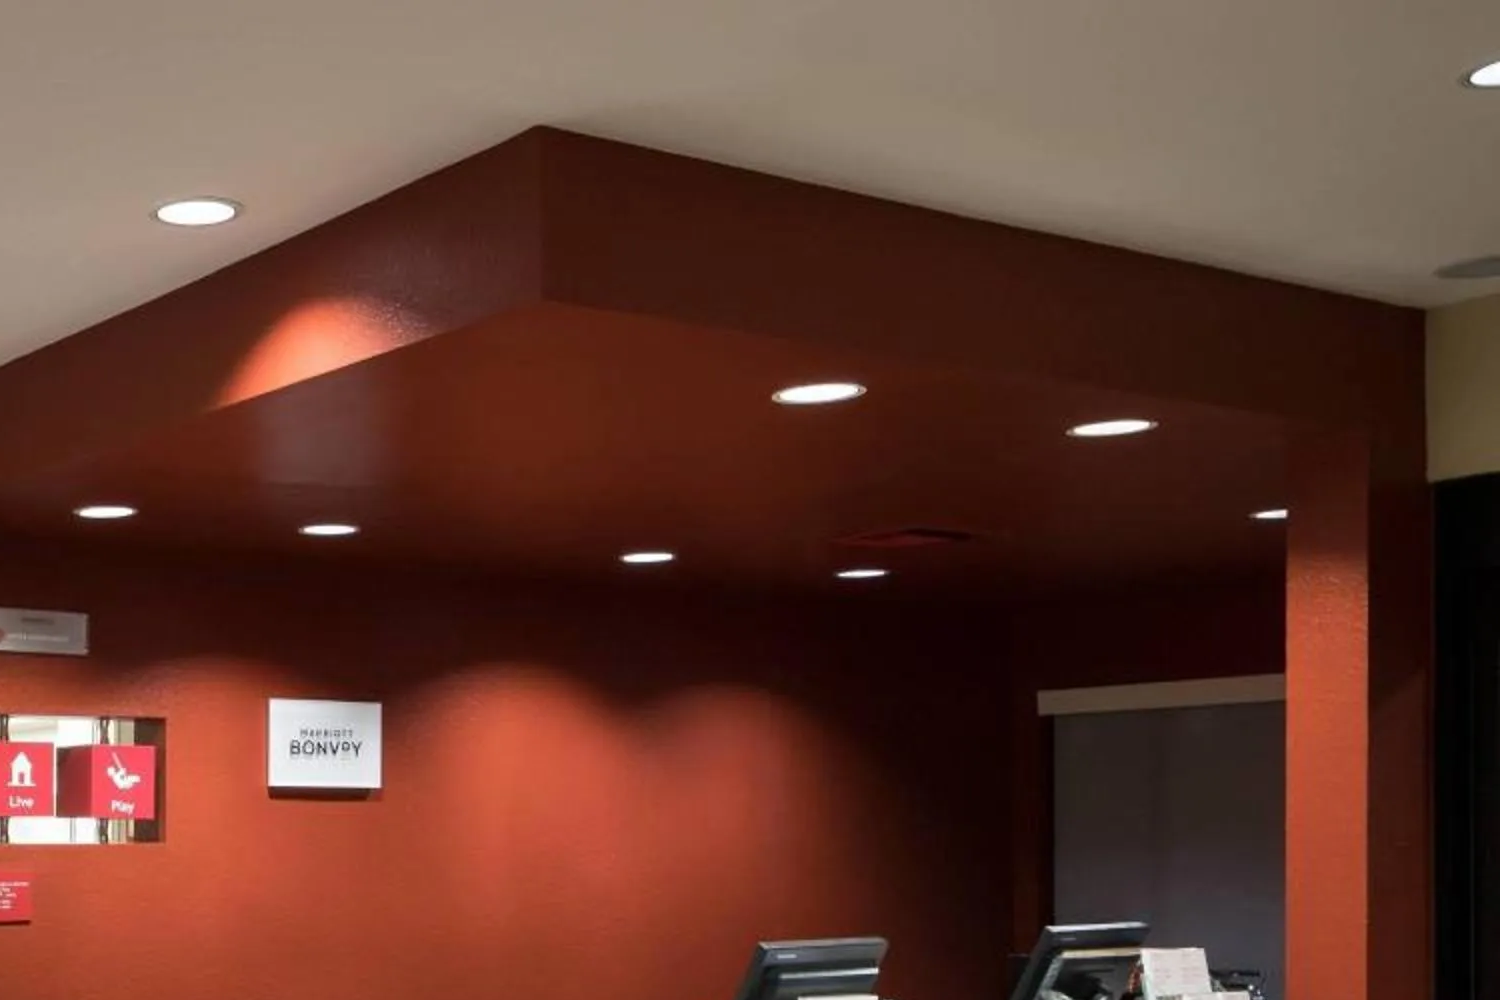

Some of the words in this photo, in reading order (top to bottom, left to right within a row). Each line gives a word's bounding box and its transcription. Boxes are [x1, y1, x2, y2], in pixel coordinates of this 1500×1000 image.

[289, 739, 363, 758] BONVOY
[8, 796, 34, 809] Live
[111, 799, 135, 815] Play
